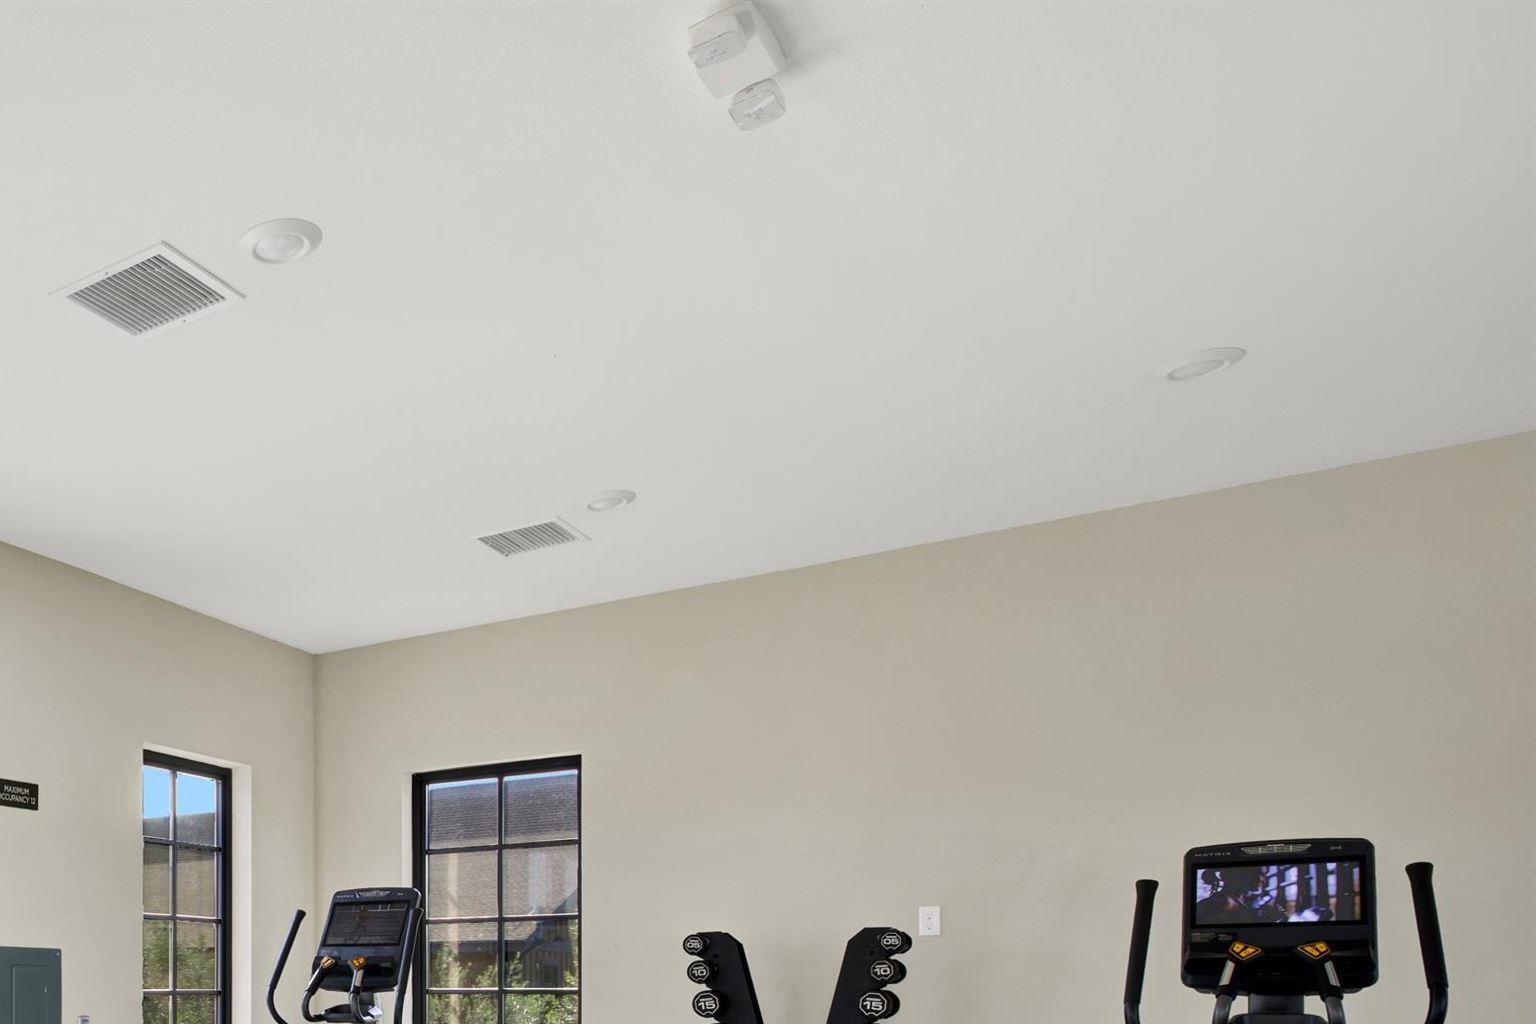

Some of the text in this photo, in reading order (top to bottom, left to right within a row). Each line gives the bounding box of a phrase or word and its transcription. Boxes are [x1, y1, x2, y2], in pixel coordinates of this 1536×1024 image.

[692, 969, 707, 977] 10
[874, 967, 891, 975] 10
[698, 1000, 716, 1010] 15
[863, 1001, 883, 1011] 15
